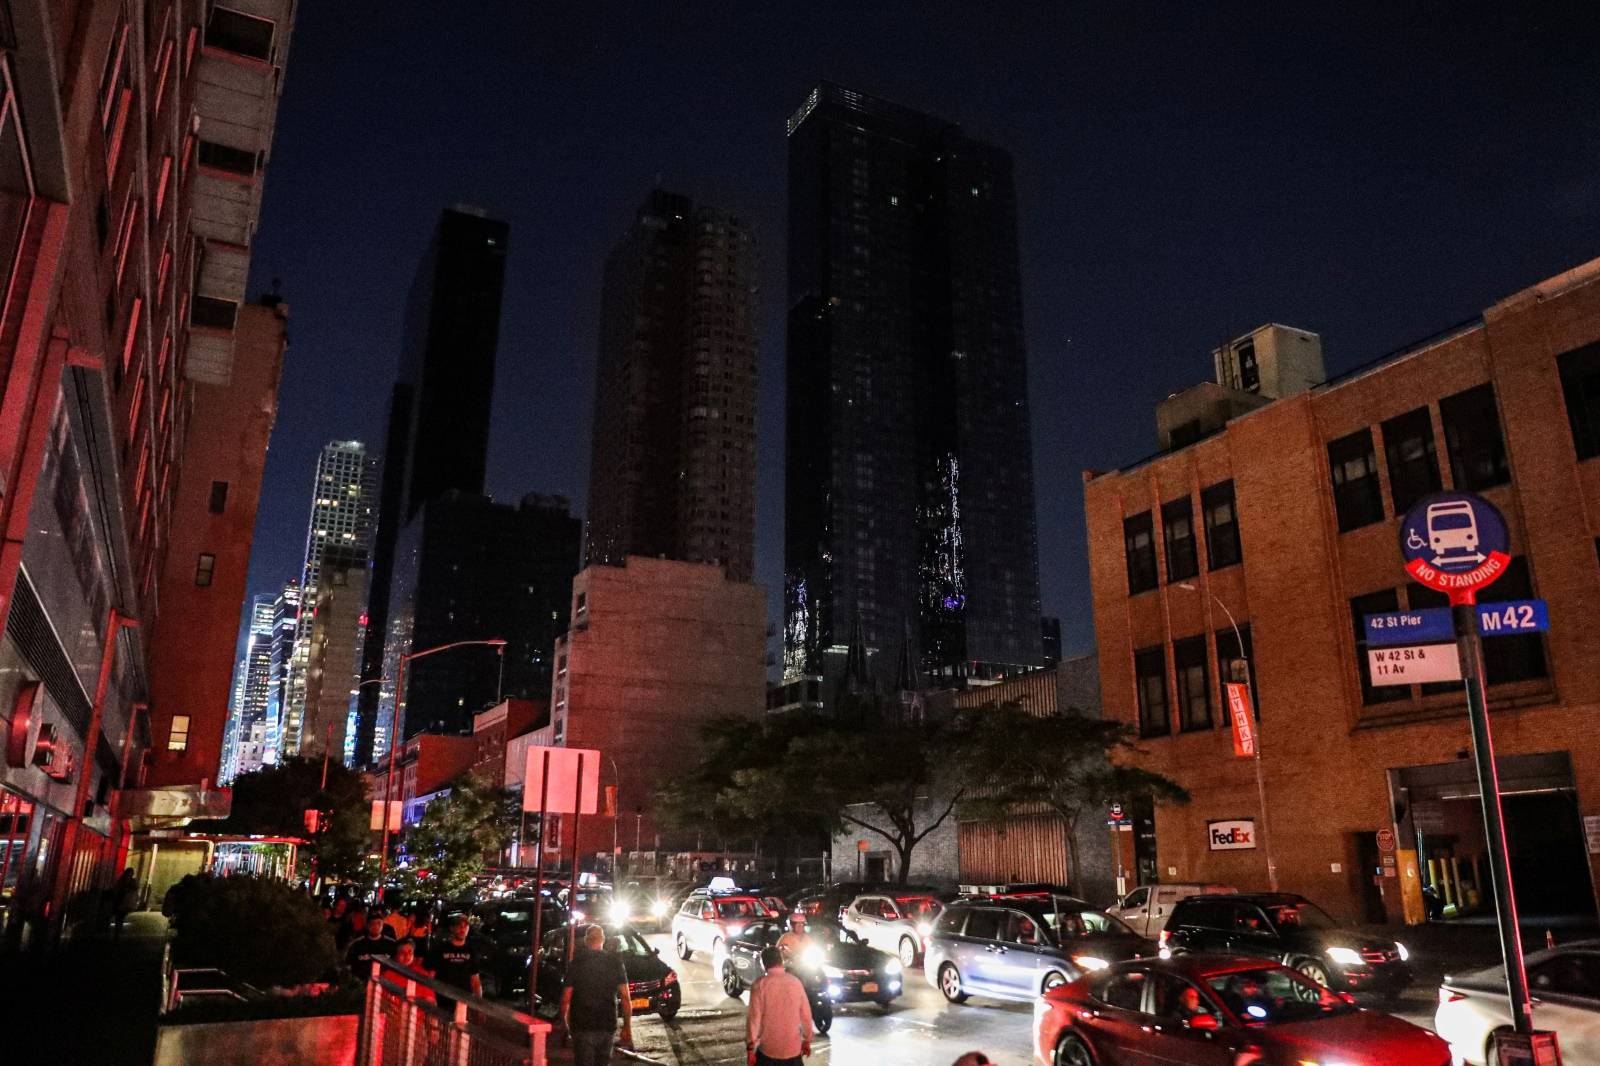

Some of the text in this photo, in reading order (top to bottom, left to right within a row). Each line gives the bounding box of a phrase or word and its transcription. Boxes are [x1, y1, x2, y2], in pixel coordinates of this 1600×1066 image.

[1416, 559, 1500, 587] NO STANDING
[1371, 615, 1422, 628] 42 St Pier
[1481, 605, 1537, 631] M42
[1375, 648, 1426, 662] W 42 St &
[1377, 663, 1405, 675] 11 Av
[1212, 828, 1250, 845] FedEx
